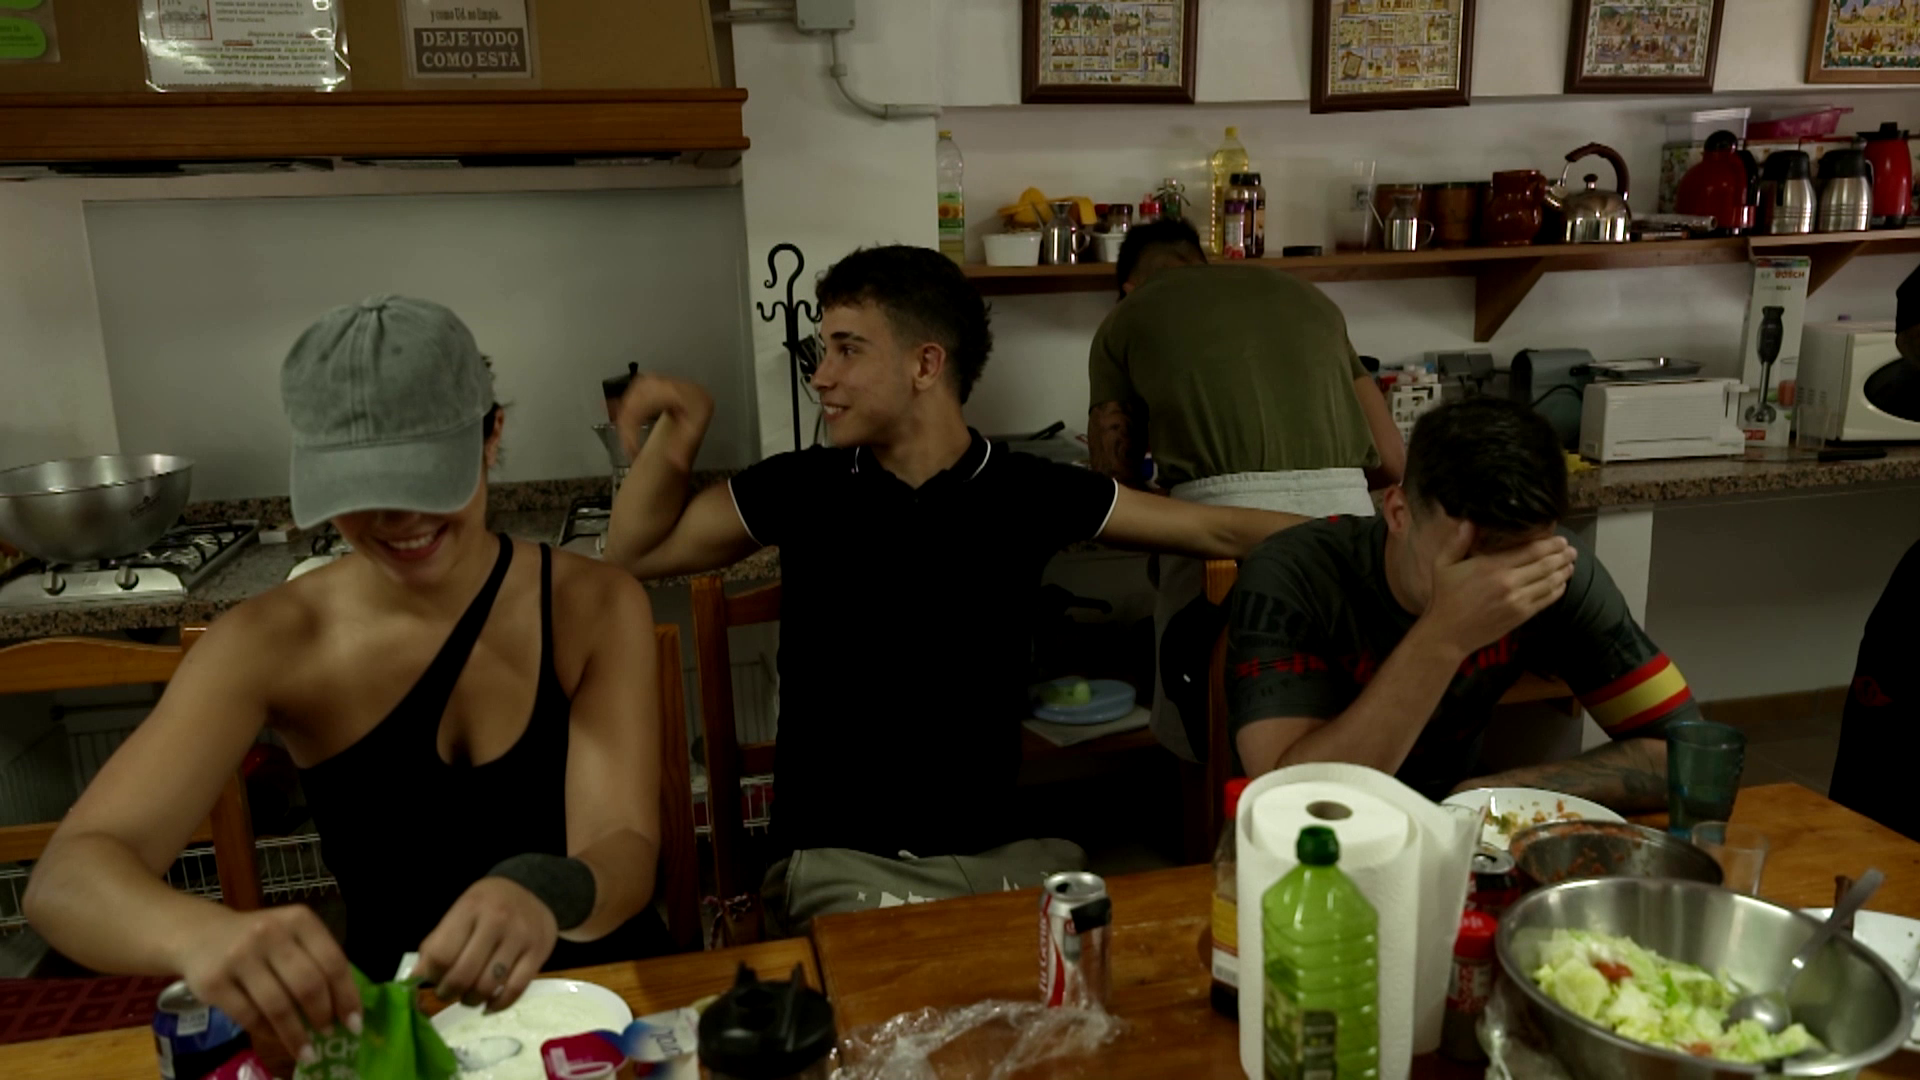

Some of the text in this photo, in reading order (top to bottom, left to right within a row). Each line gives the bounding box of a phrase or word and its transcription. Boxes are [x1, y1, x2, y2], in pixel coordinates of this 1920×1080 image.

[421, 31, 519, 46] DEJE TODO
[422, 51, 473, 67] COMO
